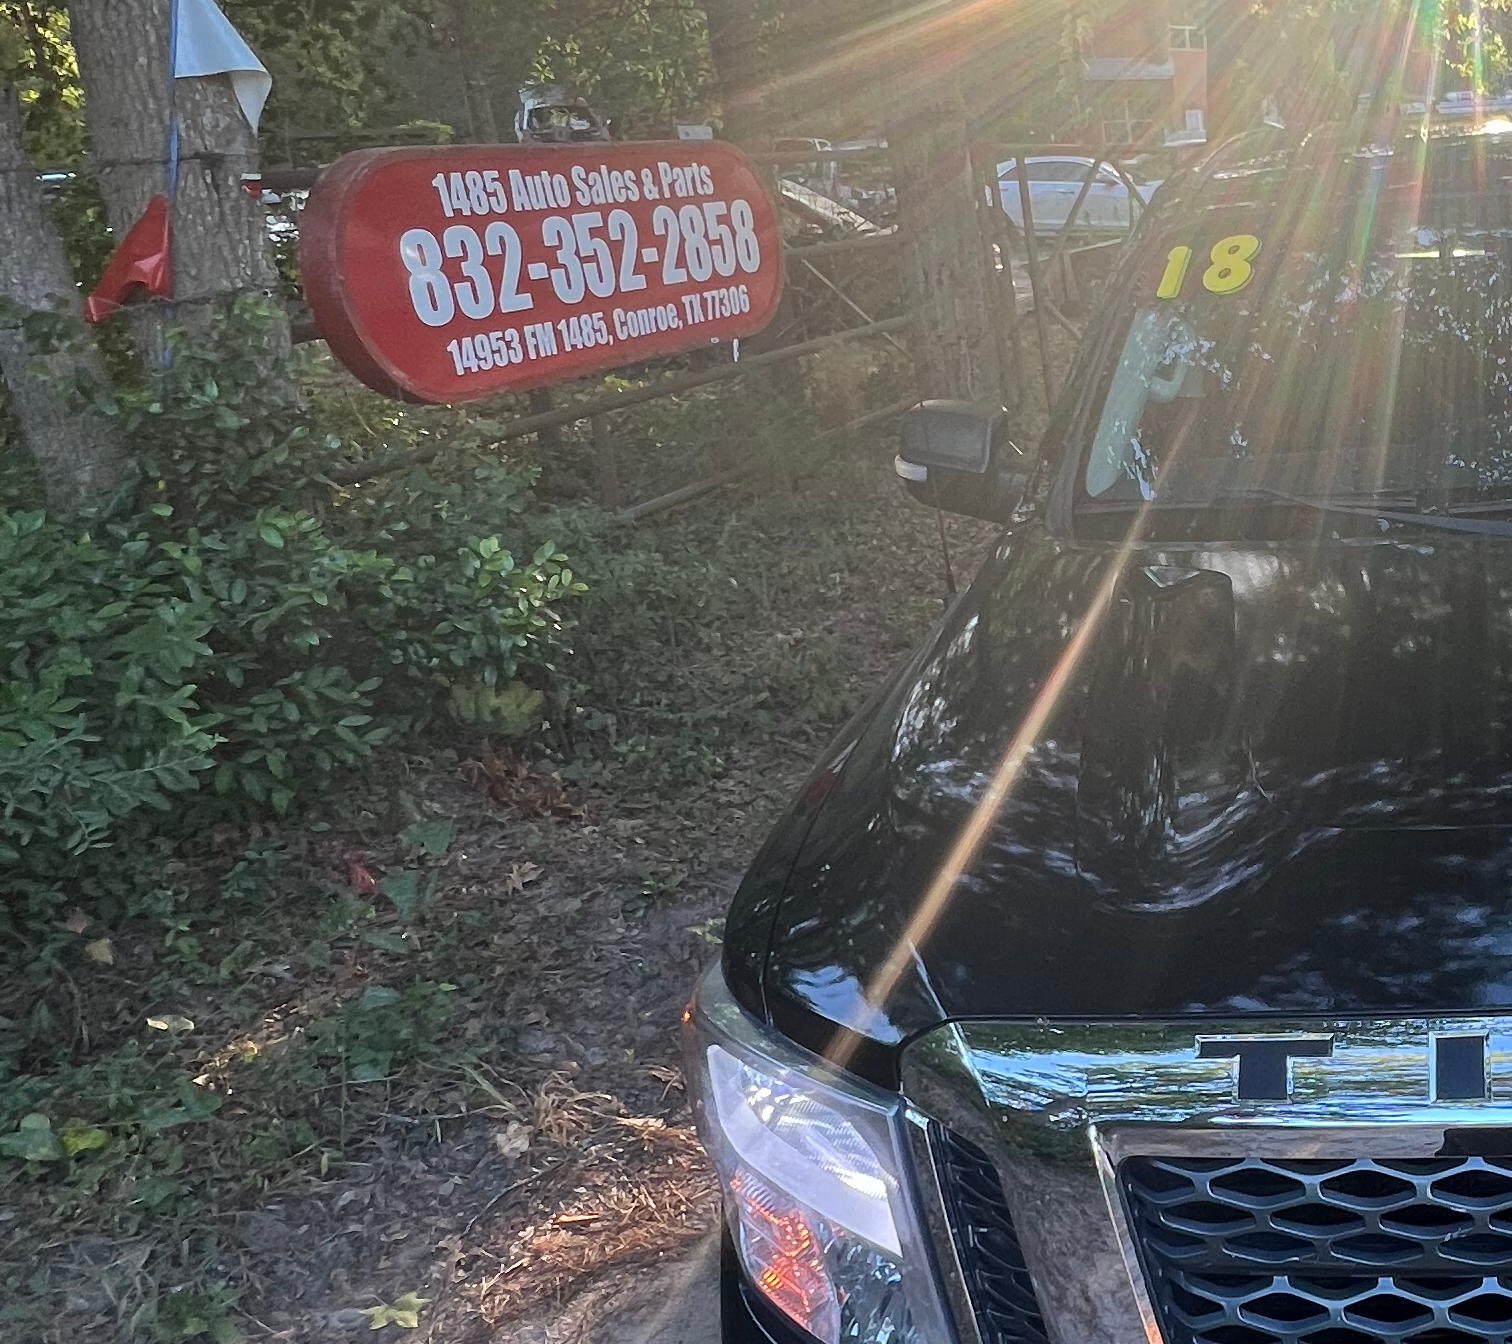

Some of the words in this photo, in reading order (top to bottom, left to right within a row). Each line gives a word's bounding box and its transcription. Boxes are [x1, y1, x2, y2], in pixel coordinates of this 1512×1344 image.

[432, 170, 507, 217] 1485
[508, 169, 571, 211] Auto
[571, 165, 640, 206] Sales
[641, 167, 660, 200] &
[657, 161, 714, 199] Parts
[400, 199, 760, 327] 832-352-2858
[1156, 234, 1261, 299] 18
[446, 327, 524, 376] 14953
[524, 321, 559, 359] FM
[557, 312, 613, 352] 1485,
[612, 303, 683, 341] Conroe,
[681, 293, 705, 325] TX
[703, 284, 750, 320] 77306
